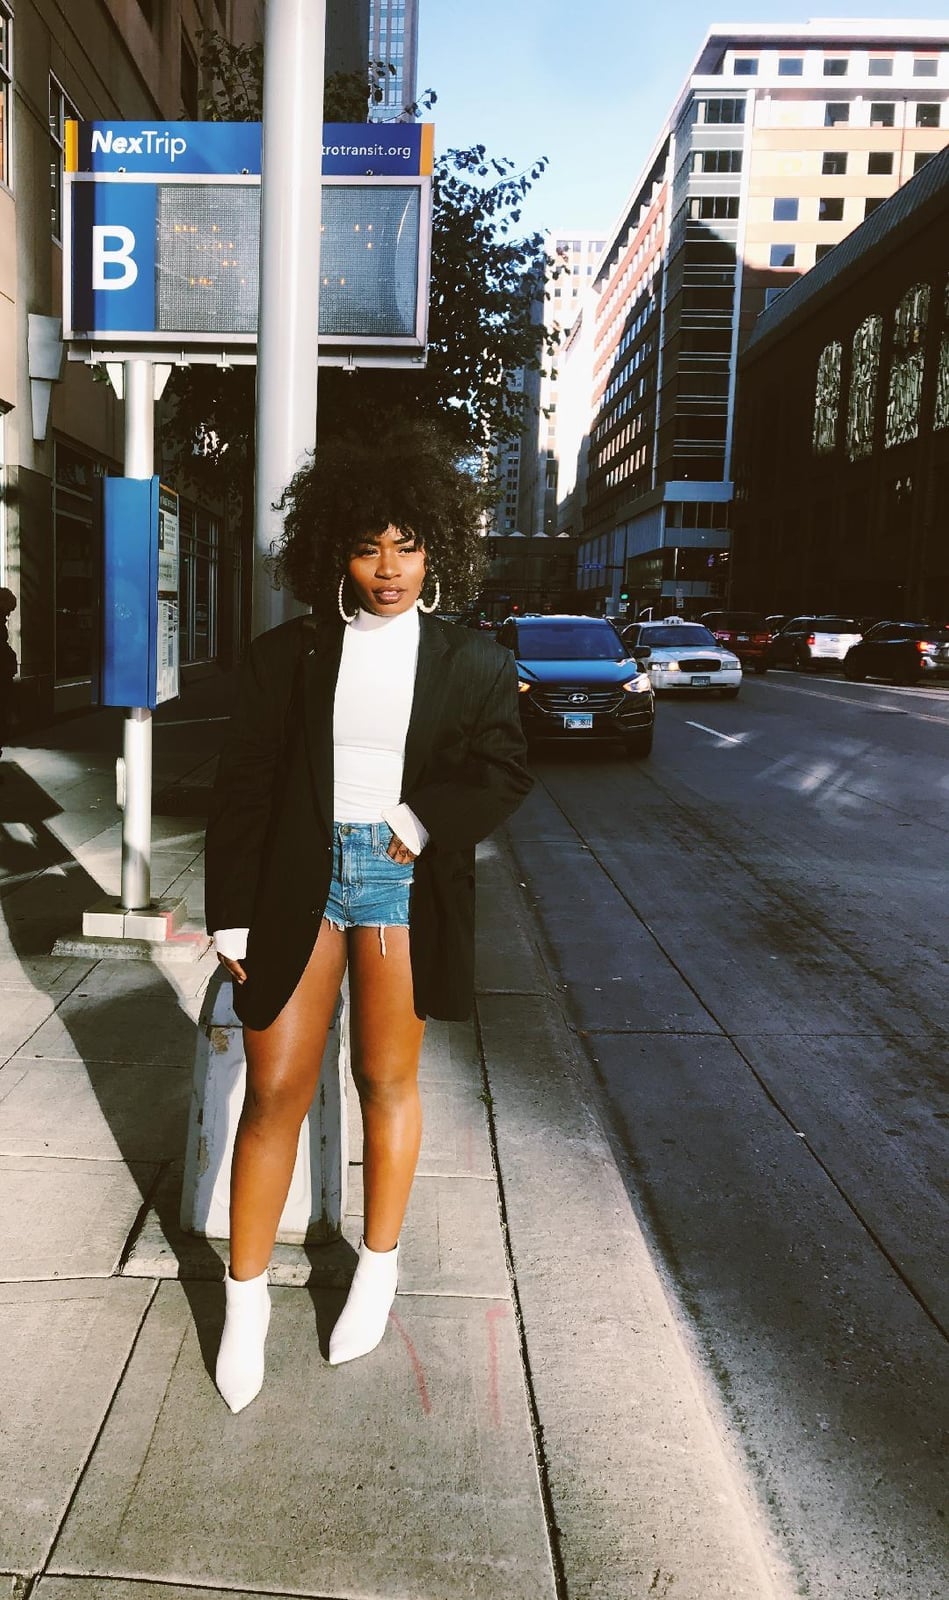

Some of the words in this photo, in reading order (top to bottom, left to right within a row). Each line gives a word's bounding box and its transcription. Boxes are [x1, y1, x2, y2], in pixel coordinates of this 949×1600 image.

[91, 130, 187, 162] NexTrip
[320, 143, 411, 159] trotransit.org
[92, 225, 138, 290] B
